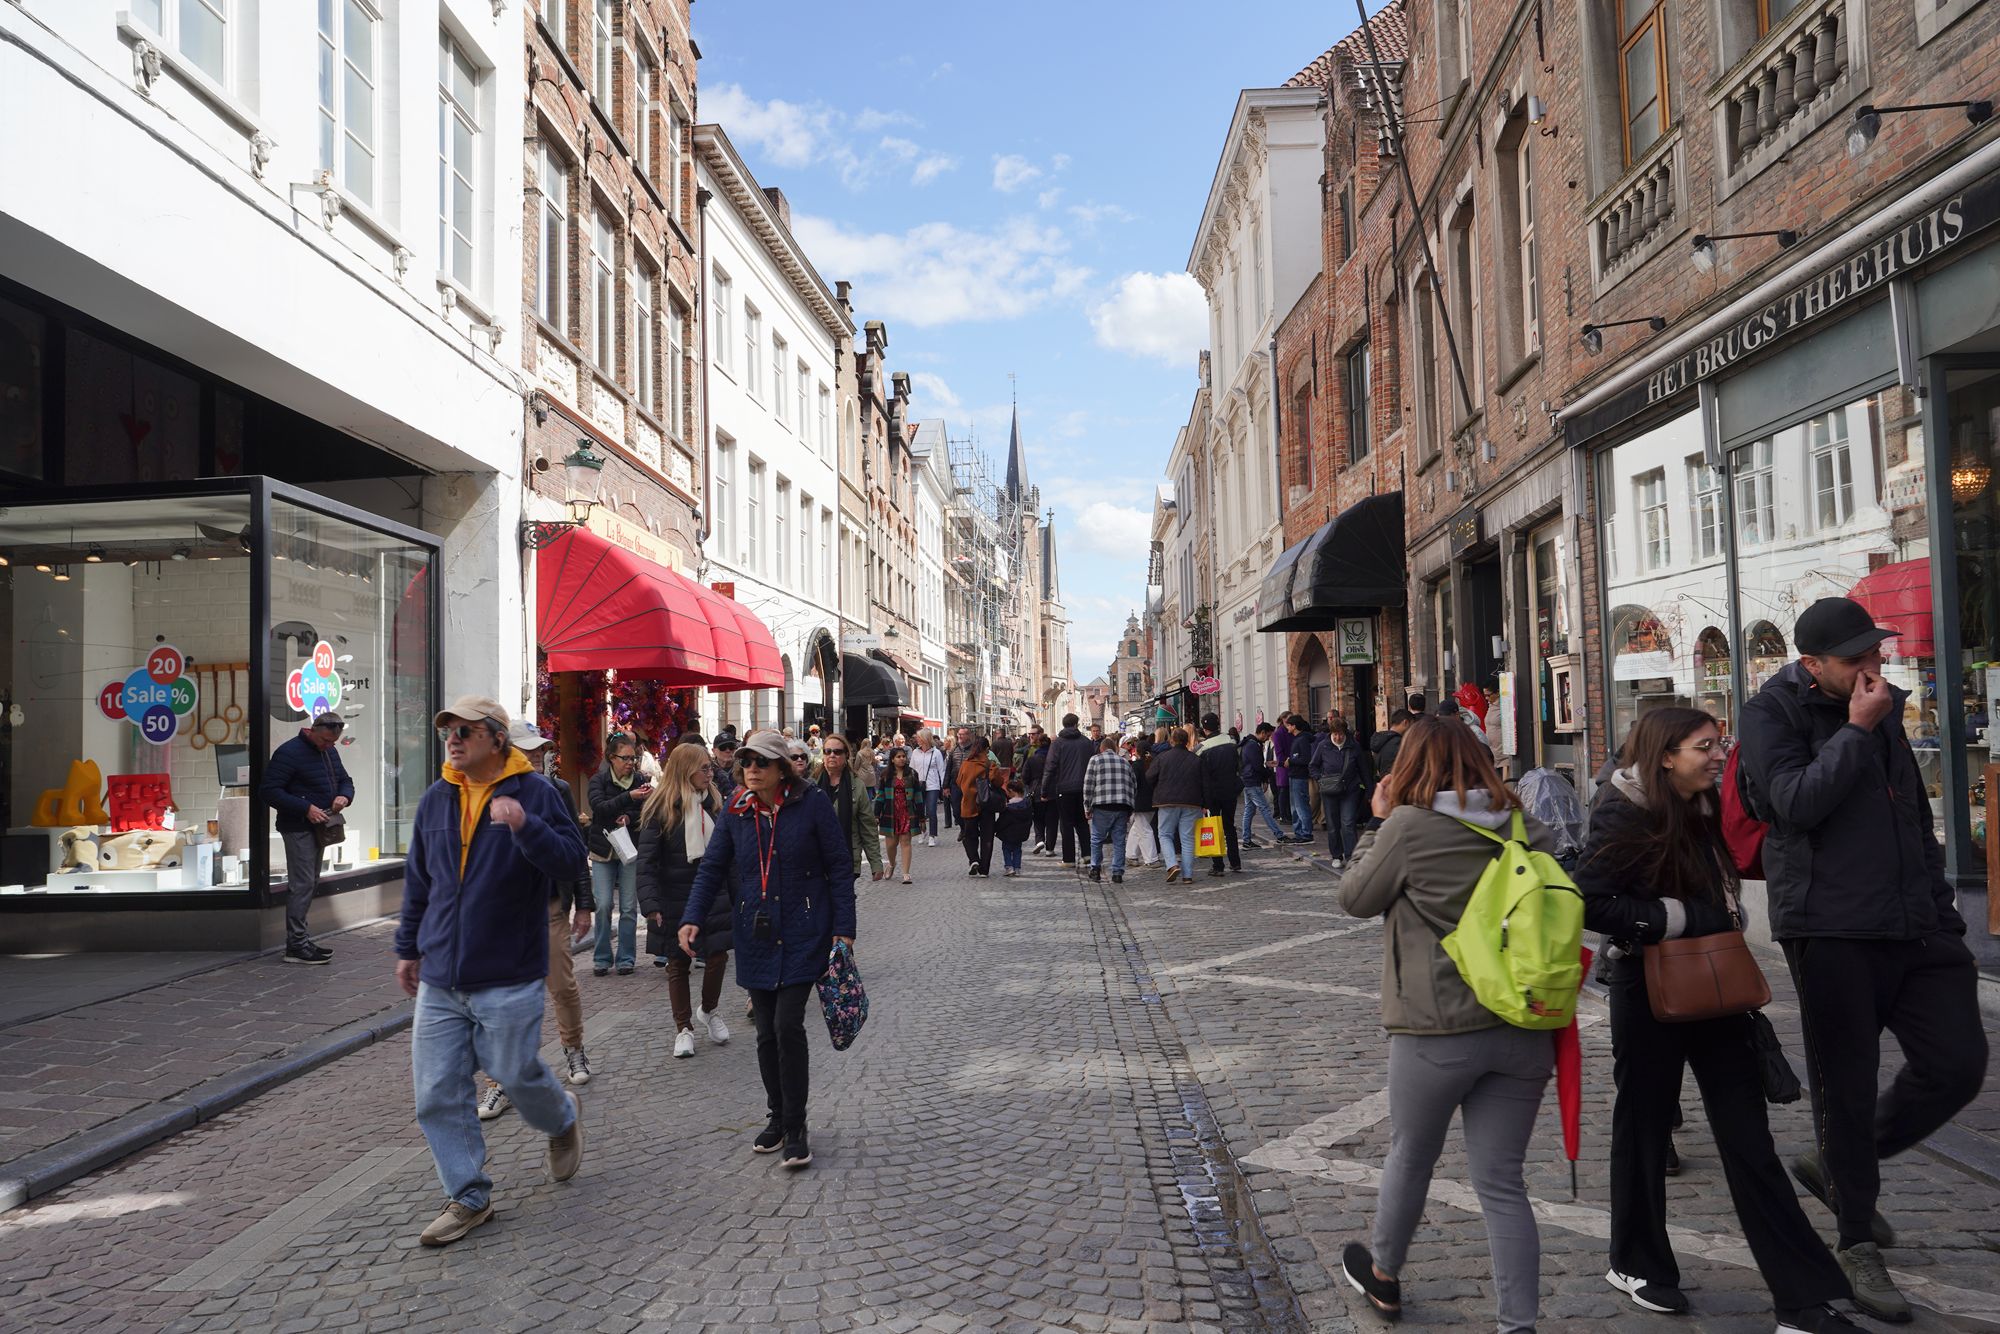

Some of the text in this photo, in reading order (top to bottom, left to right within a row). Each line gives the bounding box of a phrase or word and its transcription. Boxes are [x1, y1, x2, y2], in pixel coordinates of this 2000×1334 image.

[1647, 195, 1964, 404] HET BRUGS THEEHUIS
[153, 658, 176, 675] 20
[317, 653, 330, 669] 20
[127, 685, 166, 704] Sale
[171, 688, 189, 705] %
[304, 679, 325, 694] Sale
[146, 715, 169, 733] 50
